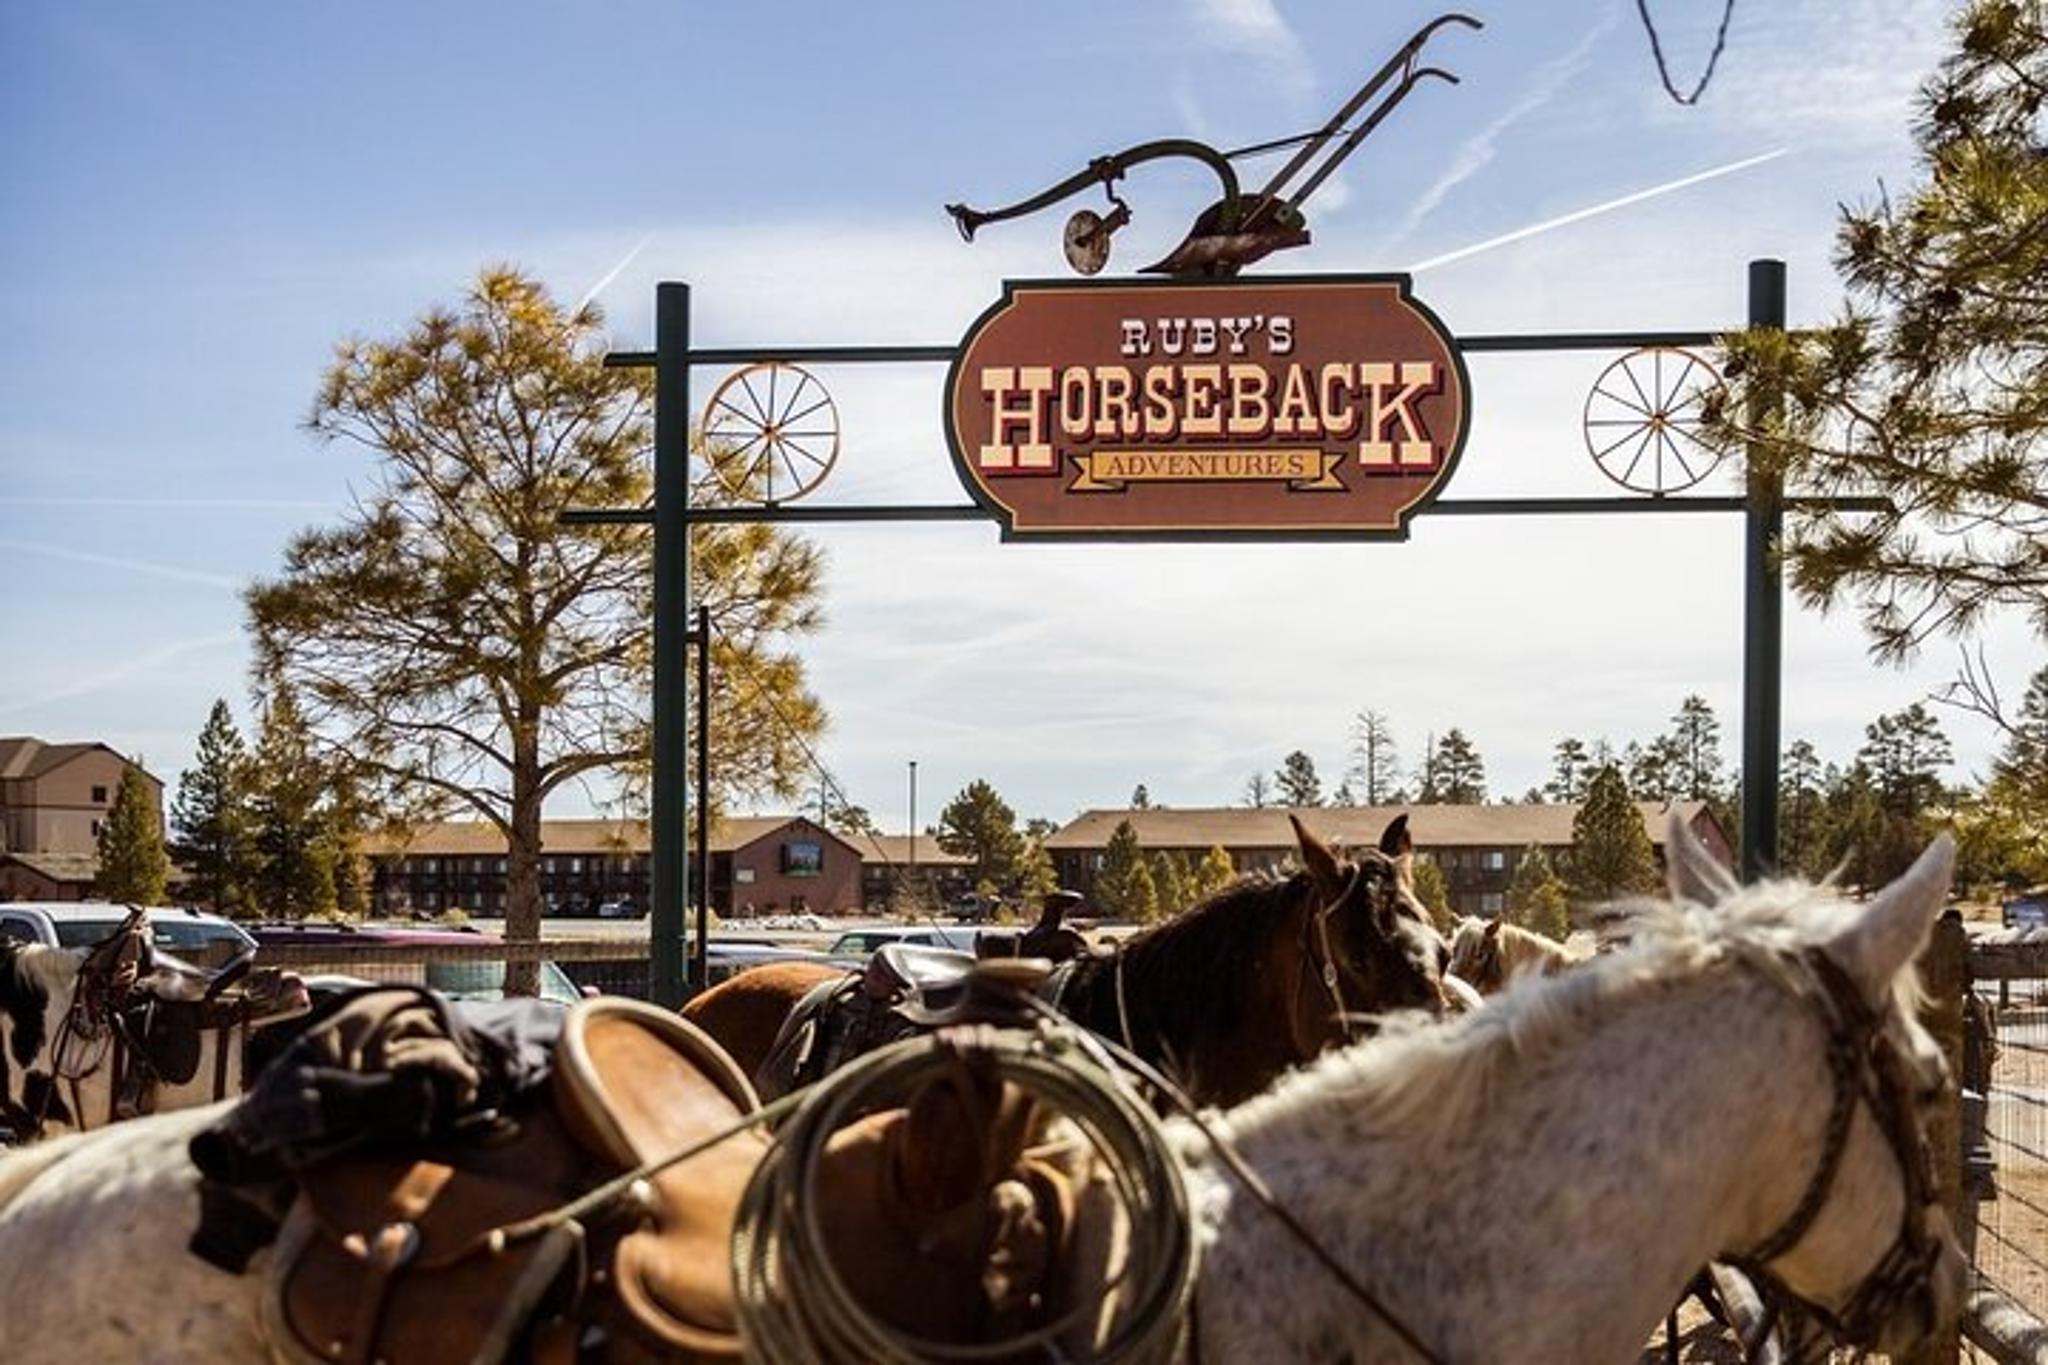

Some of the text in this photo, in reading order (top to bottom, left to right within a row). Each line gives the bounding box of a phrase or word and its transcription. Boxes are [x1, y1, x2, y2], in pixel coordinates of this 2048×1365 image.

[1121, 315, 1294, 355] RUBY'S
[980, 362, 1435, 468] HORSEBACK
[1106, 453, 1305, 477] ADVENTURES
